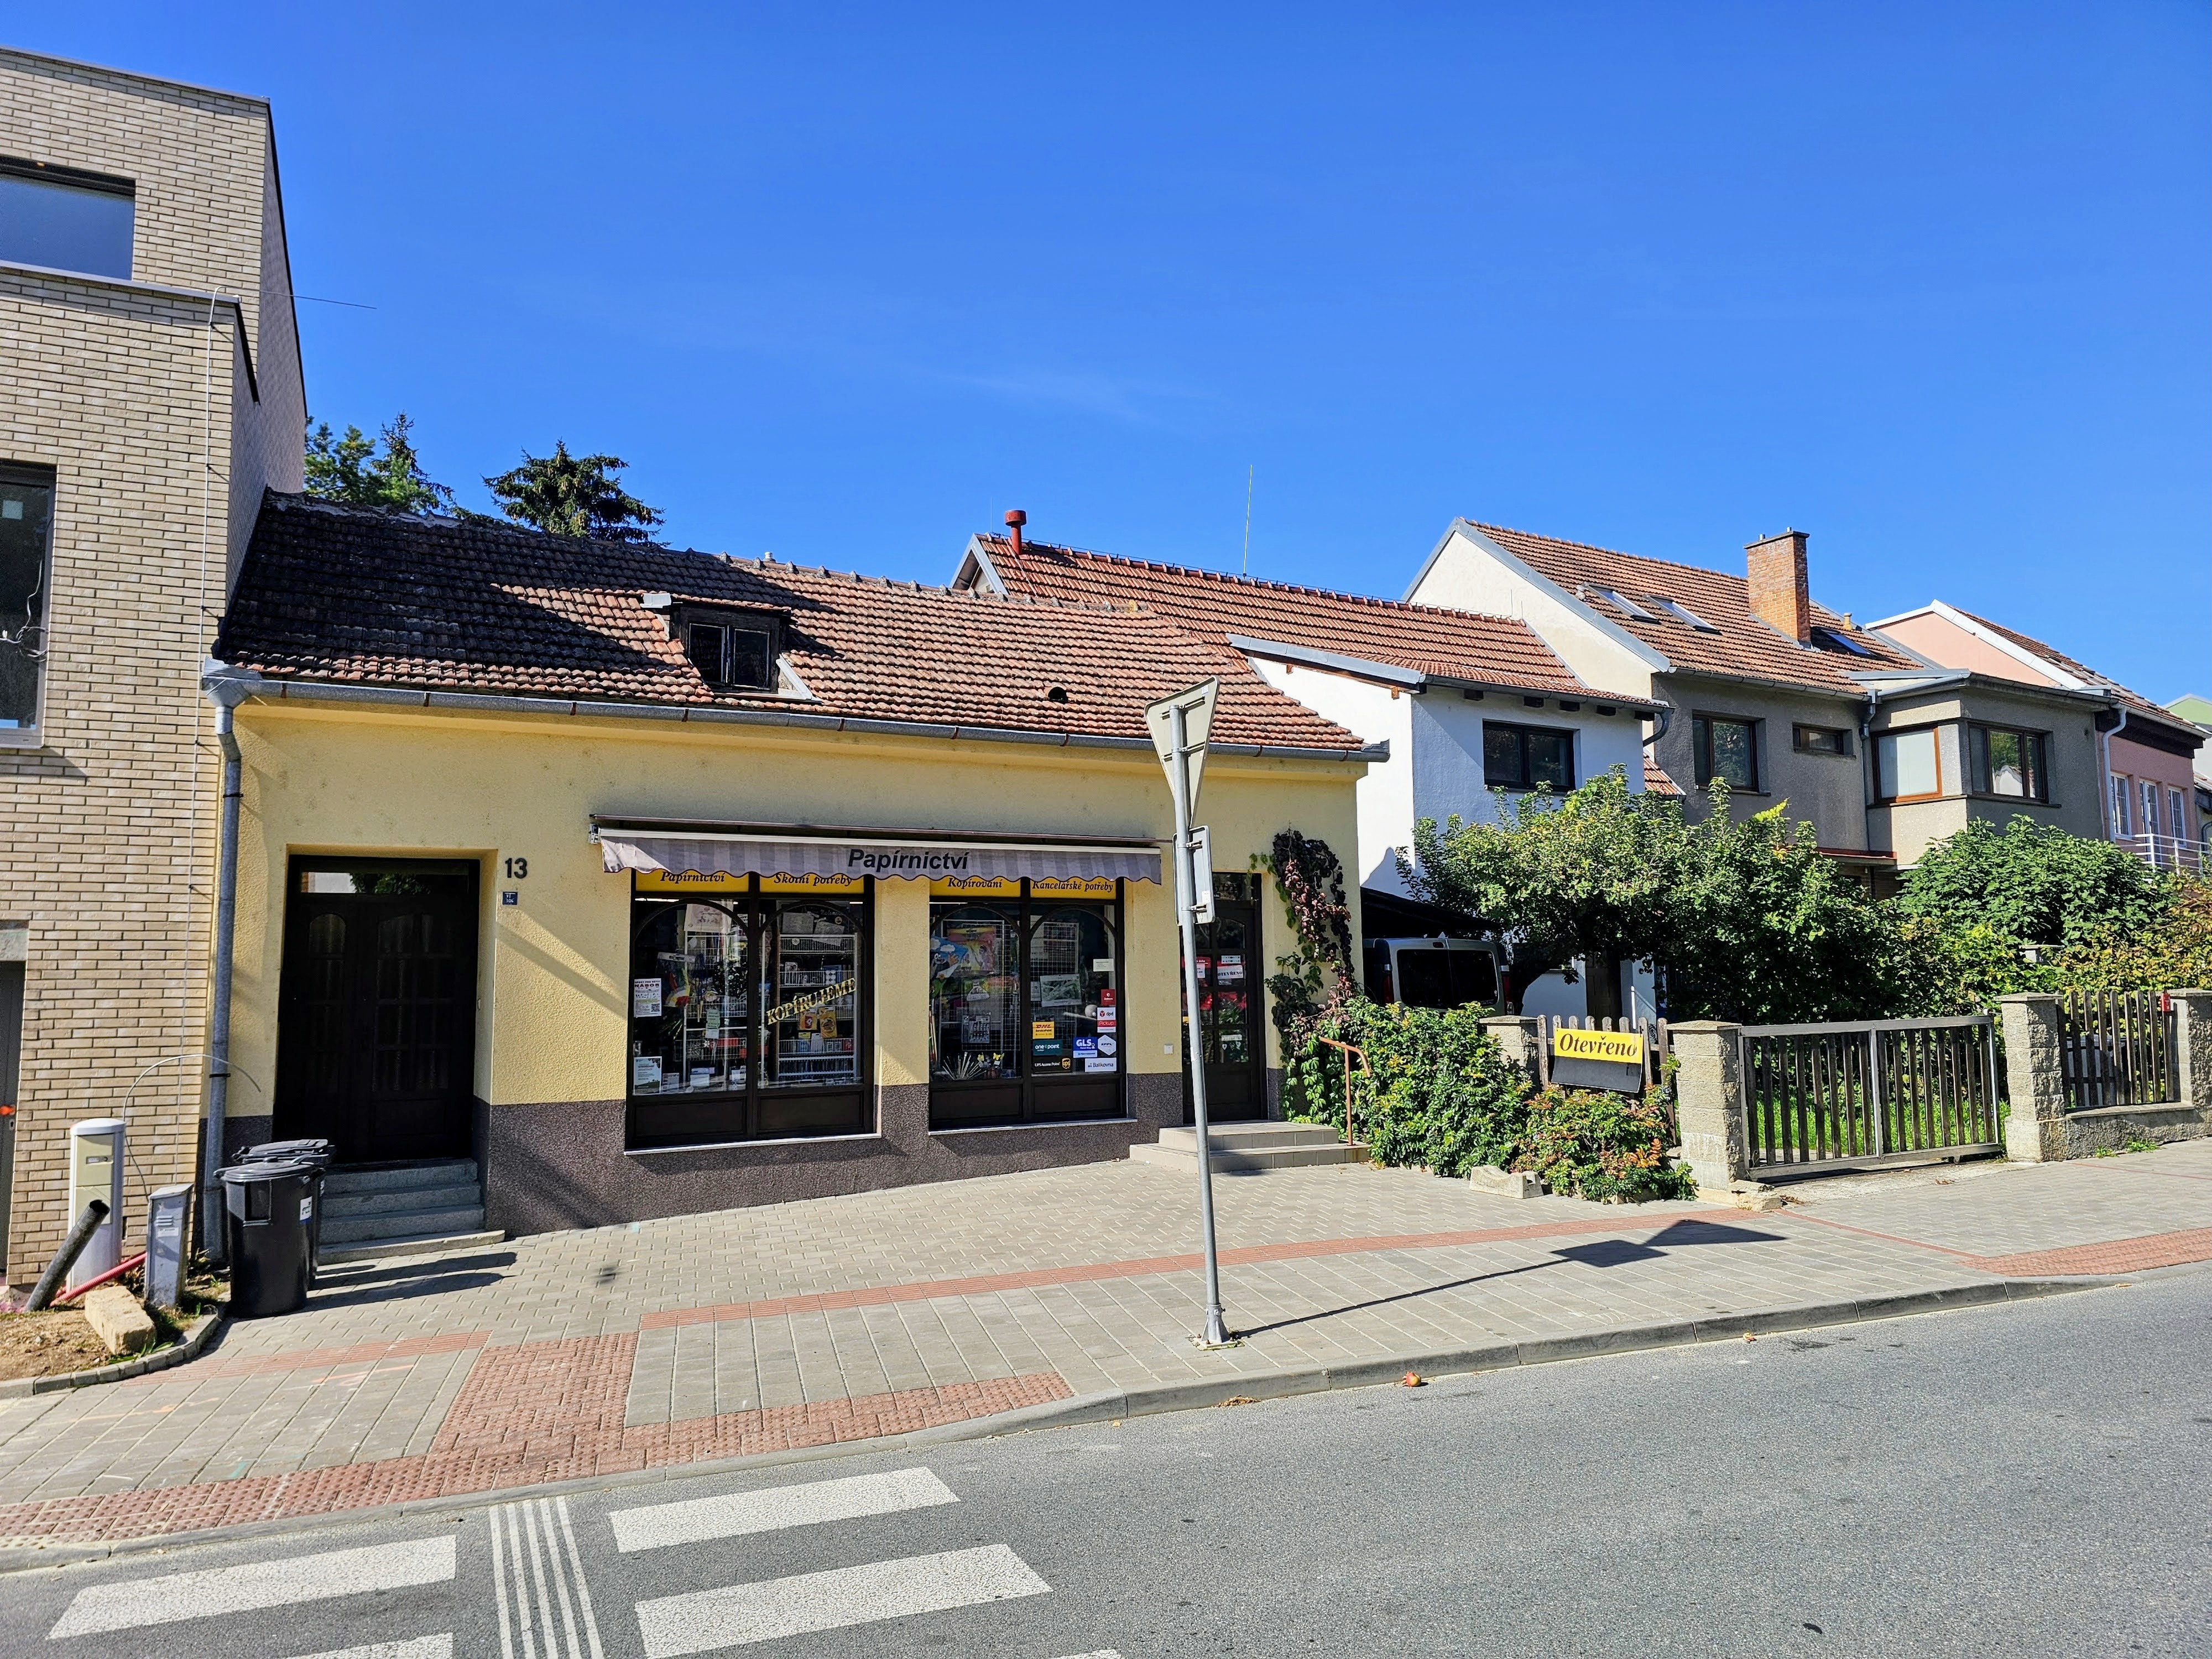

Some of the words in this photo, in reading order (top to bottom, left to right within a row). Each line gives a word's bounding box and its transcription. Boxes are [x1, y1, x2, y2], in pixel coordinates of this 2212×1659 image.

[505, 858, 528, 879] 13
[848, 849, 969, 872] Papírnictví
[660, 872, 726, 884] Papírnictví
[1084, 881, 1113, 893] potřeby
[766, 978, 857, 1025] KOPÍRUJEME
[1559, 1034, 1637, 1057] Otevřeno
